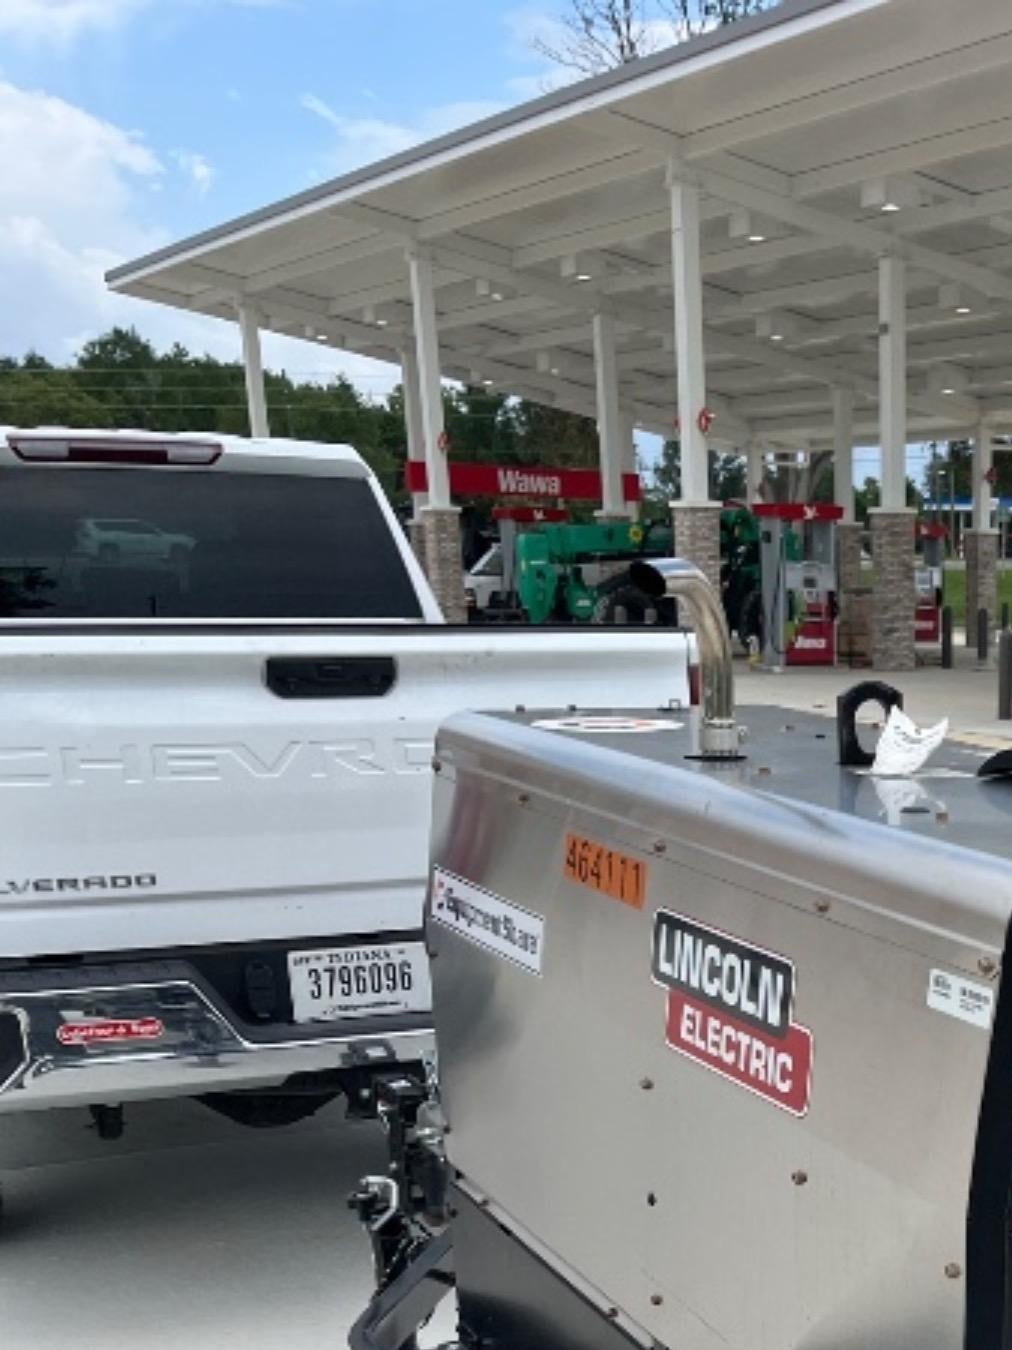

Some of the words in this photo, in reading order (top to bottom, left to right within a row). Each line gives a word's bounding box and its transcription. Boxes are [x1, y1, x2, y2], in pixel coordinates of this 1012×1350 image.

[497, 468, 561, 495] Wawa
[327, 948, 392, 964] INDIANA
[659, 922, 784, 1028] LINCOLN
[308, 959, 412, 1001] 3796096
[679, 1003, 793, 1093] ELECTRIC
